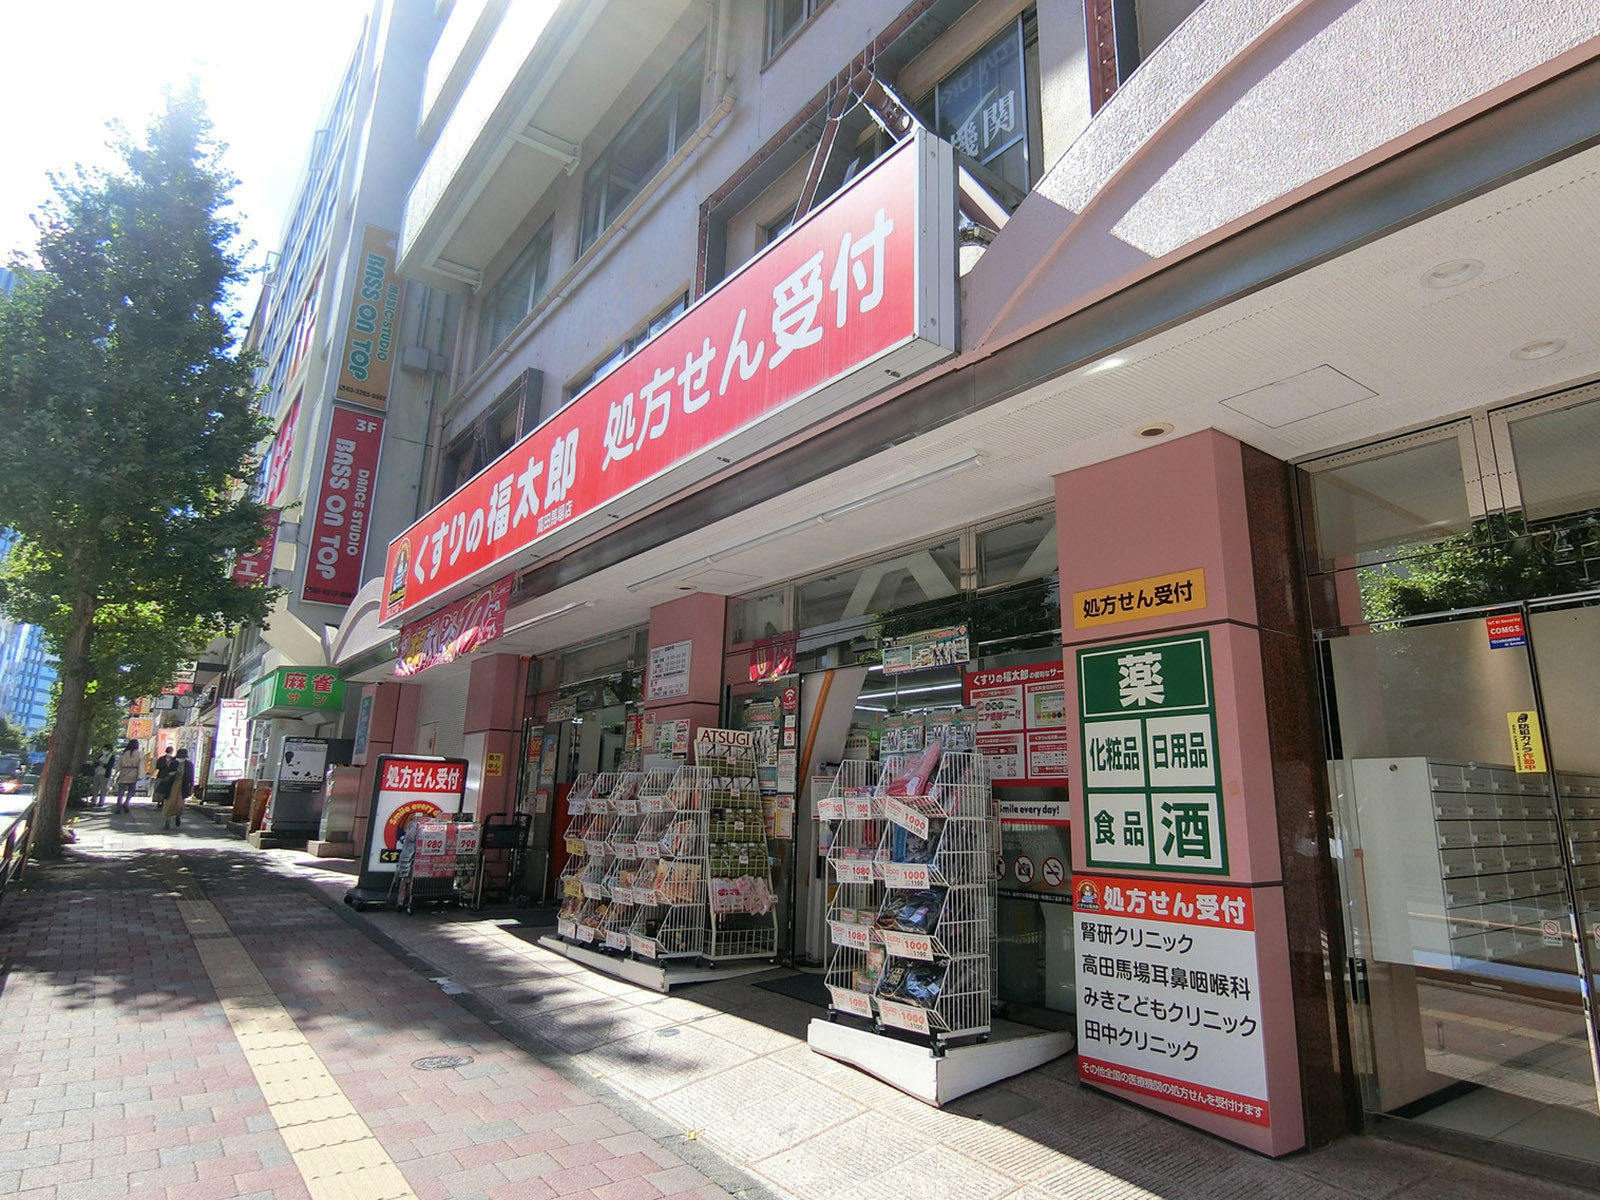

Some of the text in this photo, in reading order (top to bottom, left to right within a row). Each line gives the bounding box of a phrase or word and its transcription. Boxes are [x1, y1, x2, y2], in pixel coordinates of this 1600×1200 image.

[361, 252, 388, 302] BASS
[376, 284, 399, 362] MUSIC STUDIO
[602, 208, 894, 471] 処方せん受付
[348, 338, 373, 381] TOP
[356, 419, 377, 433] 3F
[329, 438, 356, 491] BASS
[347, 469, 370, 556] DANCE STUDIO
[414, 427, 580, 584] くすりの福太郎
[316, 534, 341, 580] TOP
[1082, 579, 1194, 619] 処方せん受付
[282, 672, 336, 693] 麻雀
[1117, 651, 1167, 708] 薬
[287, 693, 328, 706] サン
[701, 729, 750, 746] ATSUGI
[1090, 731, 1209, 772] 化粧品 日用品
[385, 765, 460, 790] 処方せん受付
[389, 806, 411, 825] Smile
[411, 803, 434, 814] every
[904, 813, 926, 830] 1000
[1019, 806, 1041, 816] every
[1042, 804, 1060, 816] day!
[427, 840, 443, 849] 980
[1093, 801, 1211, 861] 食品 酒
[852, 866, 871, 875] 1080
[903, 871, 926, 881] 1000
[1103, 884, 1247, 925] 処方せん受付
[847, 930, 867, 941] 1080
[904, 940, 929, 952] 1000
[1081, 921, 1194, 954] 腎研クリニック
[1082, 953, 1251, 1001] 高田馬場耳鼻咽喉科
[848, 998, 869, 1010] 1080
[901, 1010, 925, 1025] 1000
[1083, 986, 1258, 1037] みきこどもクリニック
[1085, 1018, 1200, 1061] 田中クリニック
